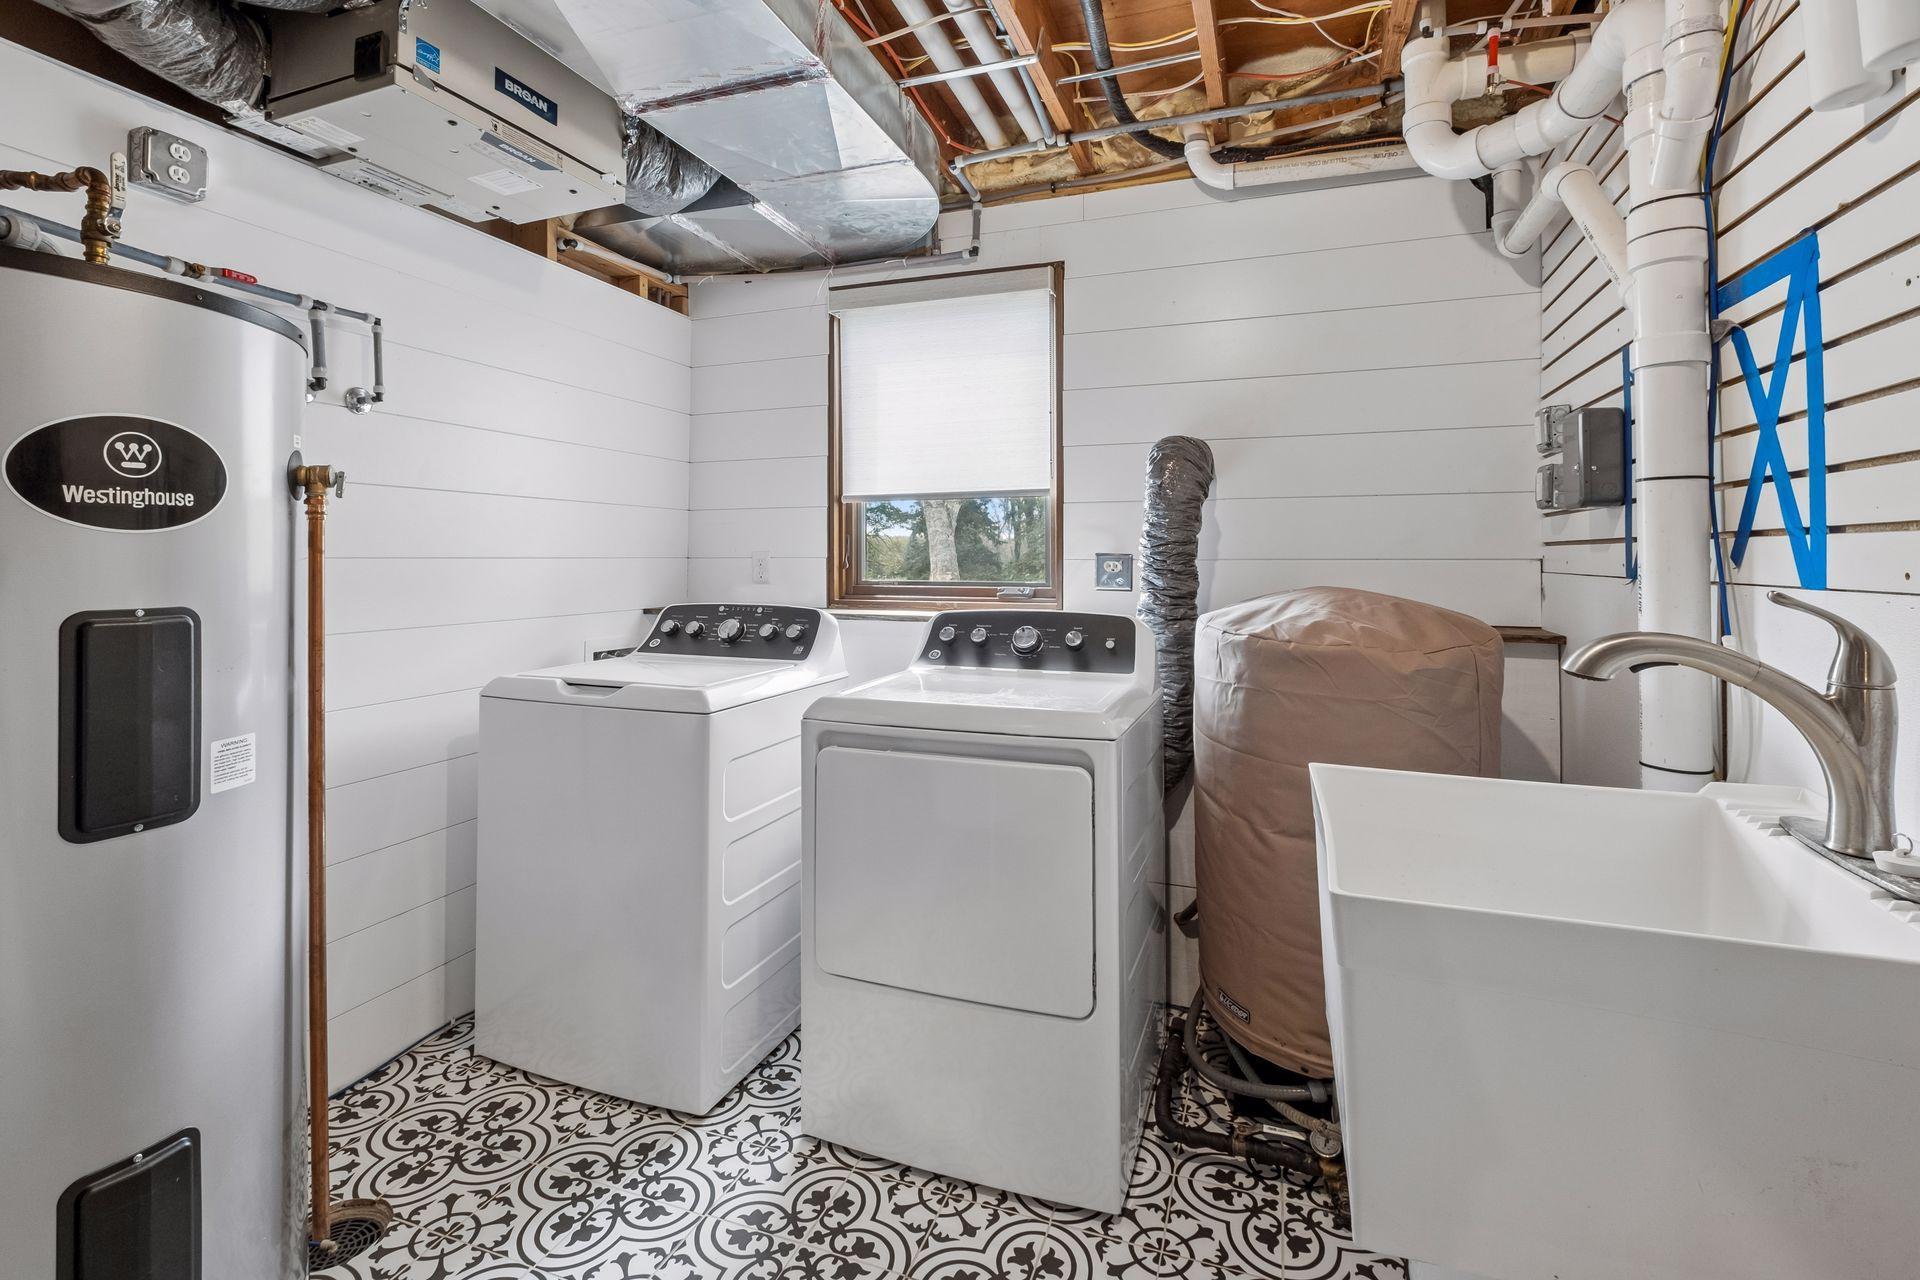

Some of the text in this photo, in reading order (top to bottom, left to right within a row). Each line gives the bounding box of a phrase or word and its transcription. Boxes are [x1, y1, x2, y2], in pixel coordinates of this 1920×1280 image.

[504, 78, 548, 113] BROAN
[498, 143, 537, 163] BROAN
[62, 484, 194, 508] Westinghouse
[220, 737, 248, 748] WARNING
